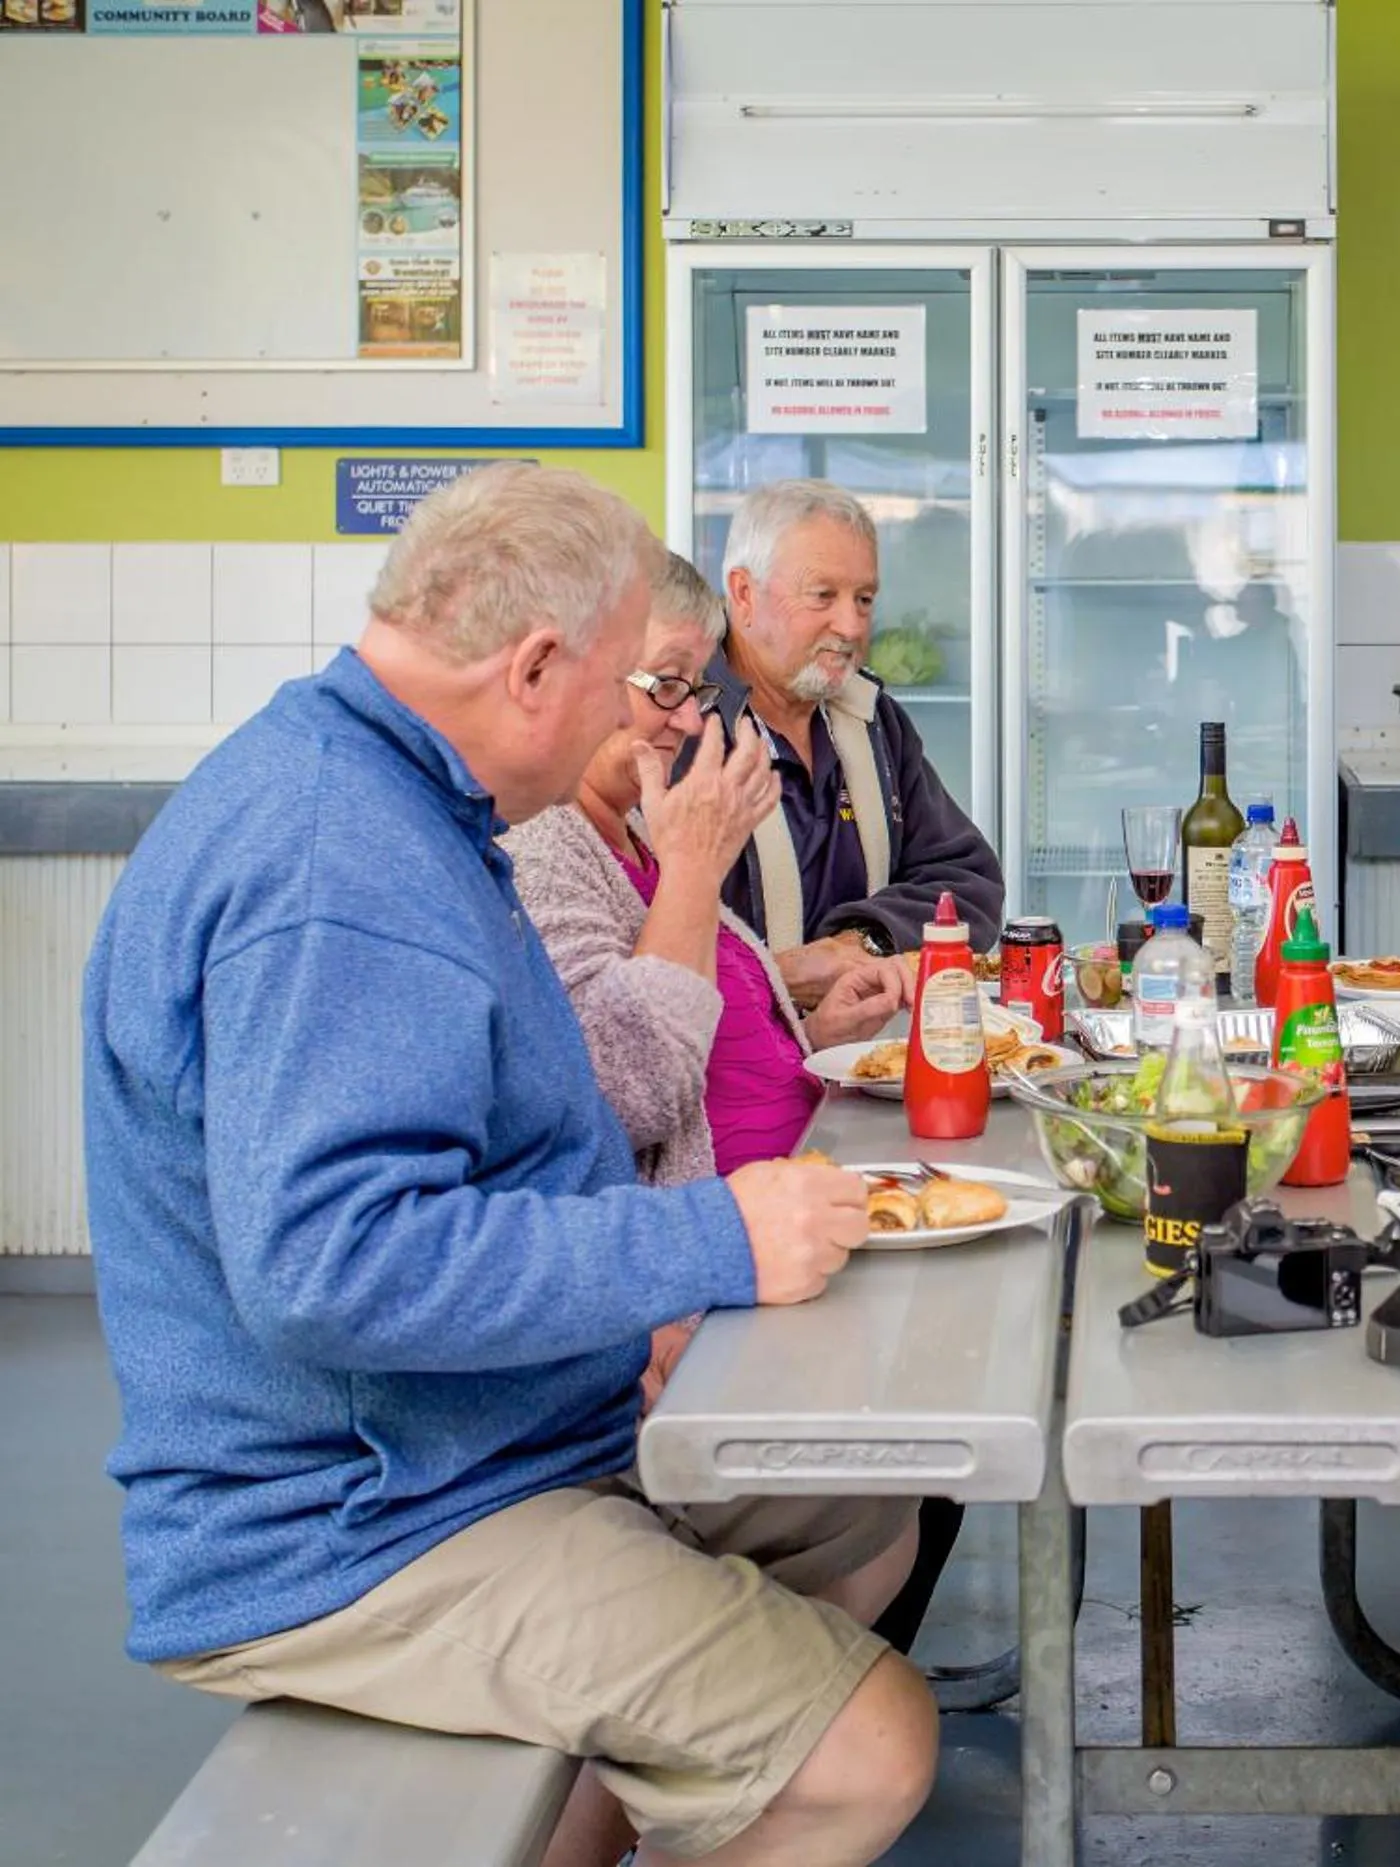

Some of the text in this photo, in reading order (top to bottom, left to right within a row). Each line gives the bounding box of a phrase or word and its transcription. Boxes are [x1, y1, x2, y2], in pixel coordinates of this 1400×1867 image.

[93, 10, 190, 22] COMMUNITY
[195, 10, 250, 22] BOARD
[762, 329, 899, 340] ALL ITEMS MUST HAVE NAME AND
[1094, 333, 1231, 343] ALL ITEMS MUST HAVE NAME AND
[765, 346, 783, 357] SITE
[785, 346, 821, 357] NUMBER
[822, 346, 858, 357] CLEARLY
[1095, 350, 1113, 360] SITE
[1116, 350, 1152, 360] NUMBER
[1153, 350, 1189, 360] CLEARLY
[791, 378, 814, 388] ITEMS
[816, 378, 833, 388] WILL
[836, 378, 844, 388] BE
[847, 378, 878, 388] THROWN
[1177, 382, 1210, 392] THROWN
[351, 465, 396, 478] LIGHTS
[399, 465, 409, 478] &
[411, 465, 458, 478] POWER
[356, 500, 393, 514] QUIET
[761, 1443, 927, 1470] CAPRAL
[1184, 1447, 1352, 1472] CAPRAL
